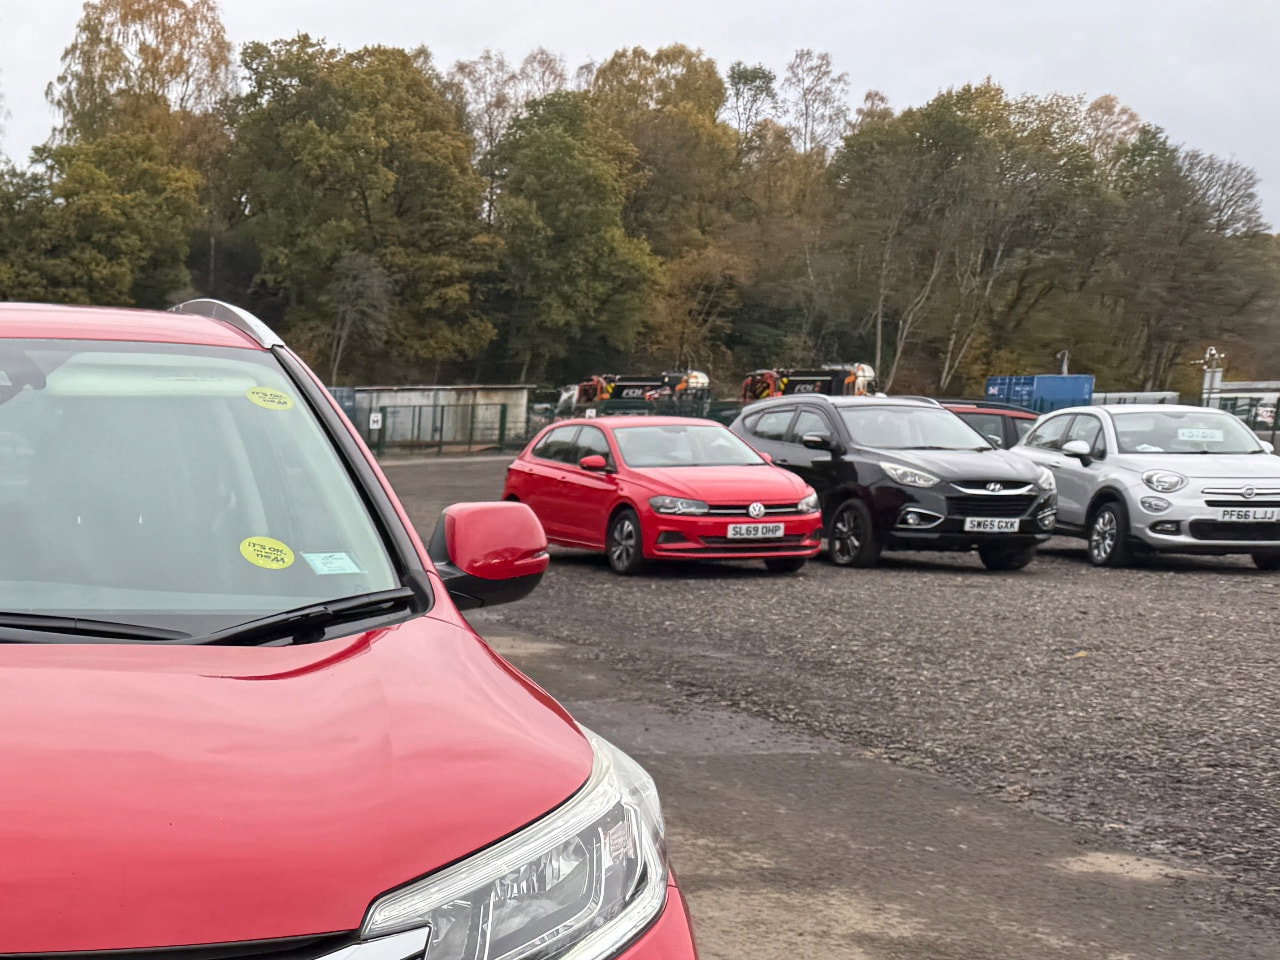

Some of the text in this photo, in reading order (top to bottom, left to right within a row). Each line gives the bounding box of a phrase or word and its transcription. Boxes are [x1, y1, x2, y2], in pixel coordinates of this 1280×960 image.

[1222, 509, 1275, 520] PF66 LJJ
[732, 525, 759, 536] SL69
